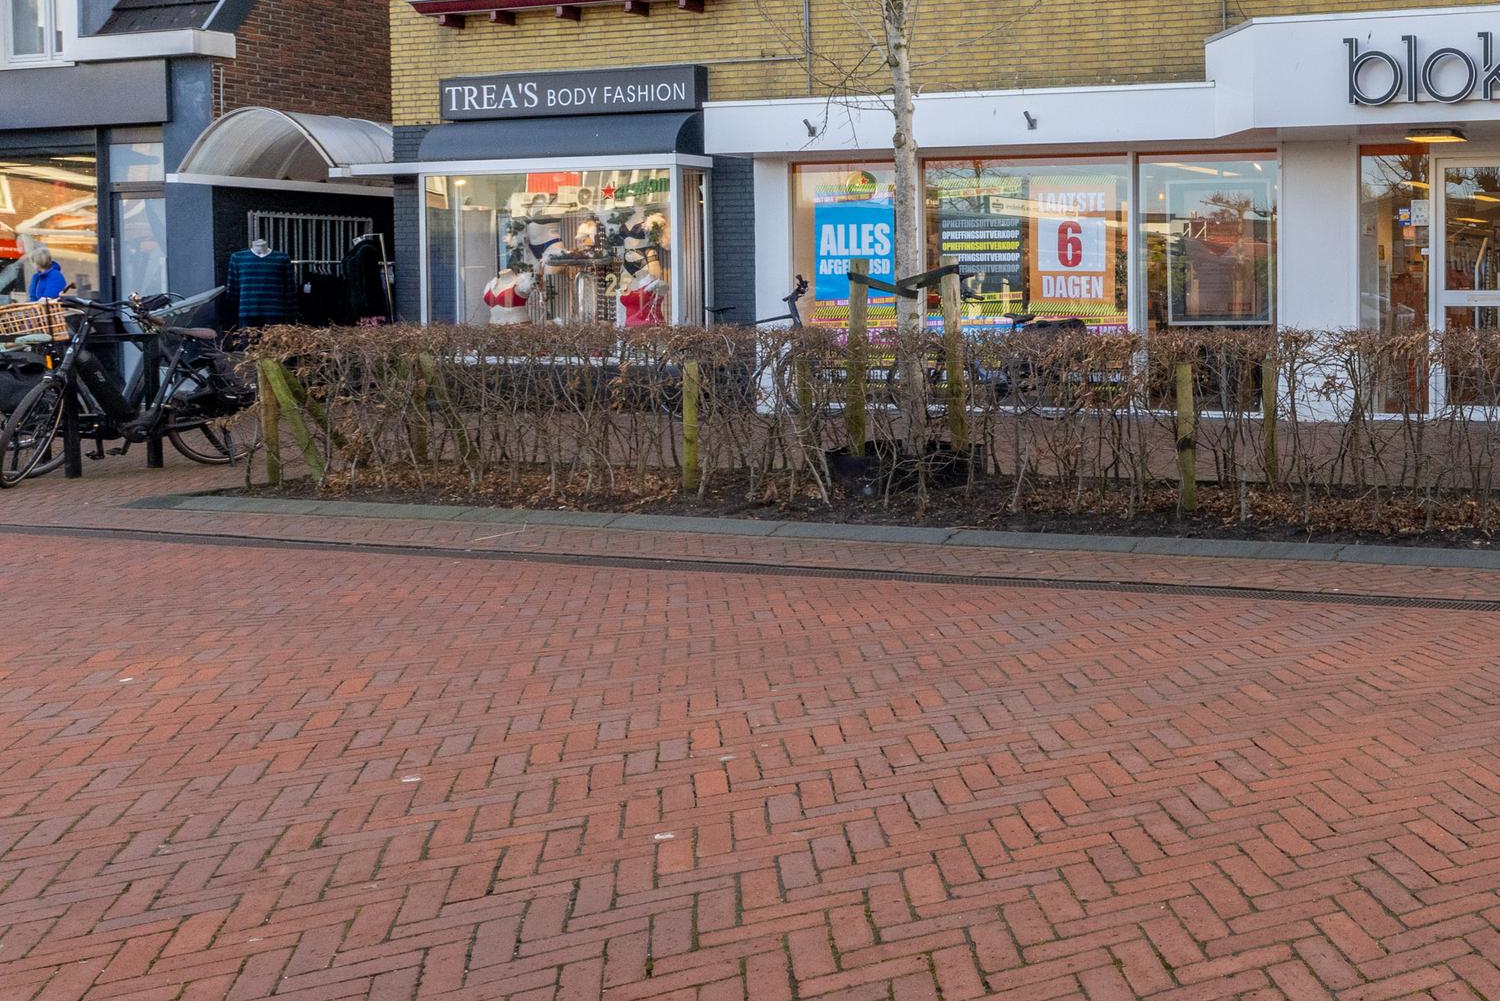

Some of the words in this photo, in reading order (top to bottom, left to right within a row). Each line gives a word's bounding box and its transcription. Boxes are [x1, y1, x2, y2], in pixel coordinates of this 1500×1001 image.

[445, 82, 538, 111] TREA'S
[547, 87, 597, 107] BODY
[603, 82, 686, 104] FASHION
[1038, 191, 1105, 212] LAATSTE
[942, 219, 1020, 228] OPHEFFINGSUITVERKOOP
[820, 223, 891, 256] ALLES
[942, 230, 1020, 240] OPHEFFINGSUITVERKOOP
[942, 241, 1020, 251] OPHEFFINGSUITVERKOOP
[1057, 220, 1082, 268] 6
[942, 252, 1020, 262] FFINGSUITVERKOOP
[820, 259, 891, 275] AFGEJSD
[959, 264, 1020, 273] FFINGSUITVERKOOP
[1042, 275, 1104, 299] DAGEN
